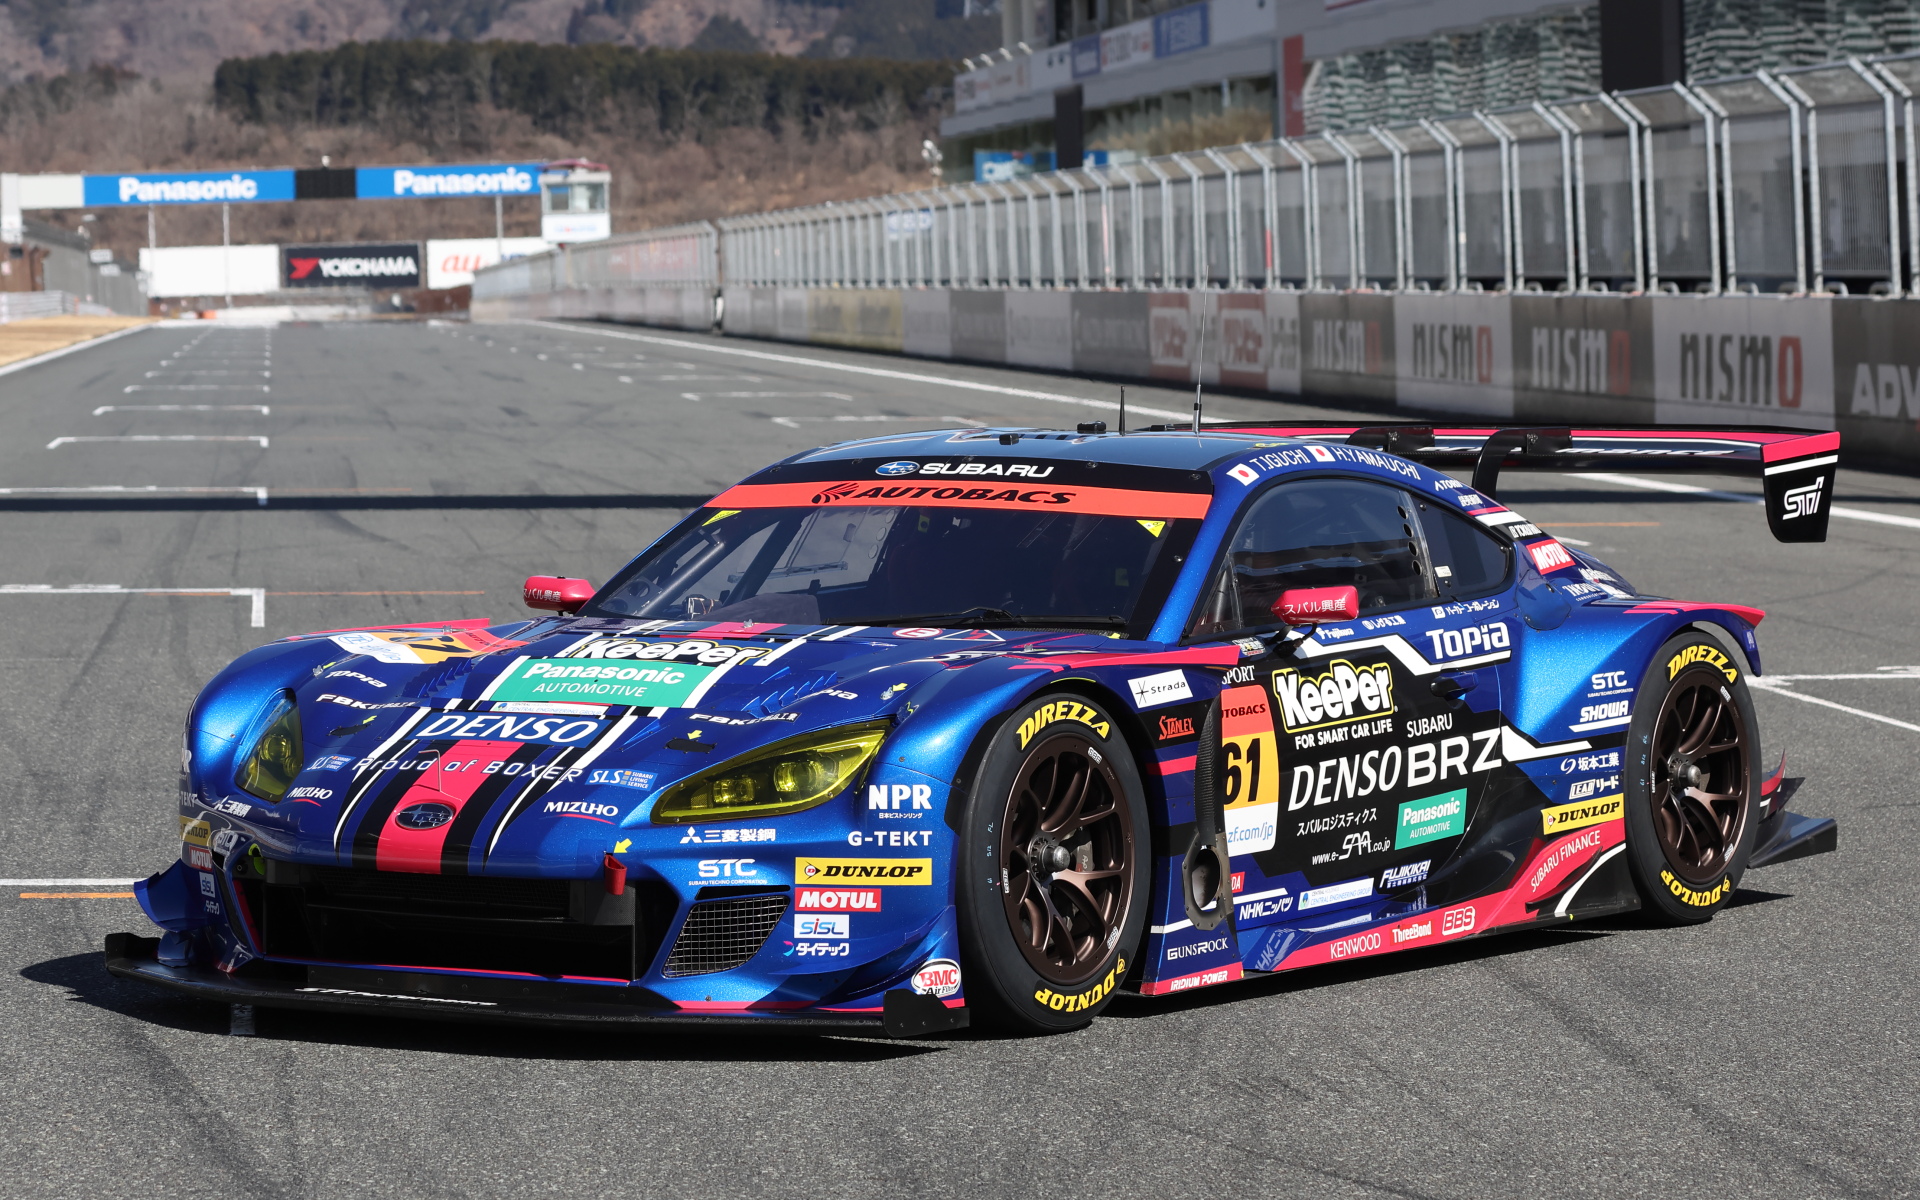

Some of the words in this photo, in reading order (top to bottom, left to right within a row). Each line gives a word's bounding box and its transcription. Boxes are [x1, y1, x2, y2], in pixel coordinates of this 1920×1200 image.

[118, 174, 258, 202] Panasonic
[394, 167, 532, 195] Panasonic
[318, 256, 418, 277] YOKOHAMA
[918, 462, 1055, 478] SUBARU
[1249, 449, 1310, 472] T.IGUCHI
[1331, 447, 1421, 480] H.YAMAUCHI
[860, 486, 1077, 504] AUTOBACS
[1532, 543, 1571, 570] MOTUL
[1284, 599, 1347, 615] スバル興産
[572, 639, 770, 665] KeePer
[522, 663, 685, 685] Panasonic
[1667, 645, 1739, 684] DIREZZA
[532, 682, 648, 698] AUTOMOTIVE
[1151, 681, 1186, 694] Strada
[1591, 671, 1628, 690] STC
[1274, 661, 1392, 731] KeePer
[1580, 700, 1629, 722] SHOWA
[416, 715, 599, 743] DENSO
[1016, 700, 1111, 751] DIREZZA
[1295, 733, 1316, 750] FOR
[1318, 726, 1349, 746] SMART
[1351, 722, 1371, 739] CAR
[1372, 718, 1393, 736] LIFE
[1407, 713, 1453, 738] SUBARU
[352, 756, 438, 771] Proud
[444, 759, 480, 774] of
[482, 760, 584, 783] BOXER
[1221, 738, 1261, 806] 61
[1288, 745, 1402, 812] DENSO
[1407, 727, 1502, 788] BRZ
[1578, 752, 1620, 771] 坂本工業
[588, 770, 624, 784] SLS
[627, 781, 649, 789] SERVICE
[629, 776, 648, 784] LIVING
[631, 771, 654, 780] SUBARU
[1571, 780, 1594, 797] LEAD
[1596, 775, 1619, 793] リード
[286, 787, 333, 800] MIZUHO
[868, 784, 933, 810] NPR
[543, 801, 619, 817] MIZUHO
[1402, 797, 1460, 827] Panasonic
[1557, 801, 1621, 824] DUNLOP
[1297, 808, 1377, 837] スバルロジスティクス
[1410, 821, 1451, 839] AUTOMOTIVE
[703, 828, 776, 843] 三菱製鋼
[848, 830, 933, 847] G-TEKT
[191, 849, 212, 869] MOTUL
[698, 858, 758, 878] STC
[1531, 853, 1559, 893] SUBARU
[1560, 830, 1601, 861] FINANCE
[823, 866, 923, 878] DUNLOP
[1661, 869, 1722, 906] DUNLOP
[799, 891, 877, 909] MOTUL
[1442, 905, 1476, 935] BBS
[1392, 920, 1432, 943] ThreeBond
[796, 942, 850, 956] ダイテック
[1330, 933, 1381, 959] KENWOOD
[919, 969, 958, 987] BMC
[1170, 976, 1201, 991] IRIDIUM
[1201, 970, 1229, 985] POWER
[1035, 971, 1116, 1012] DUNLOP
